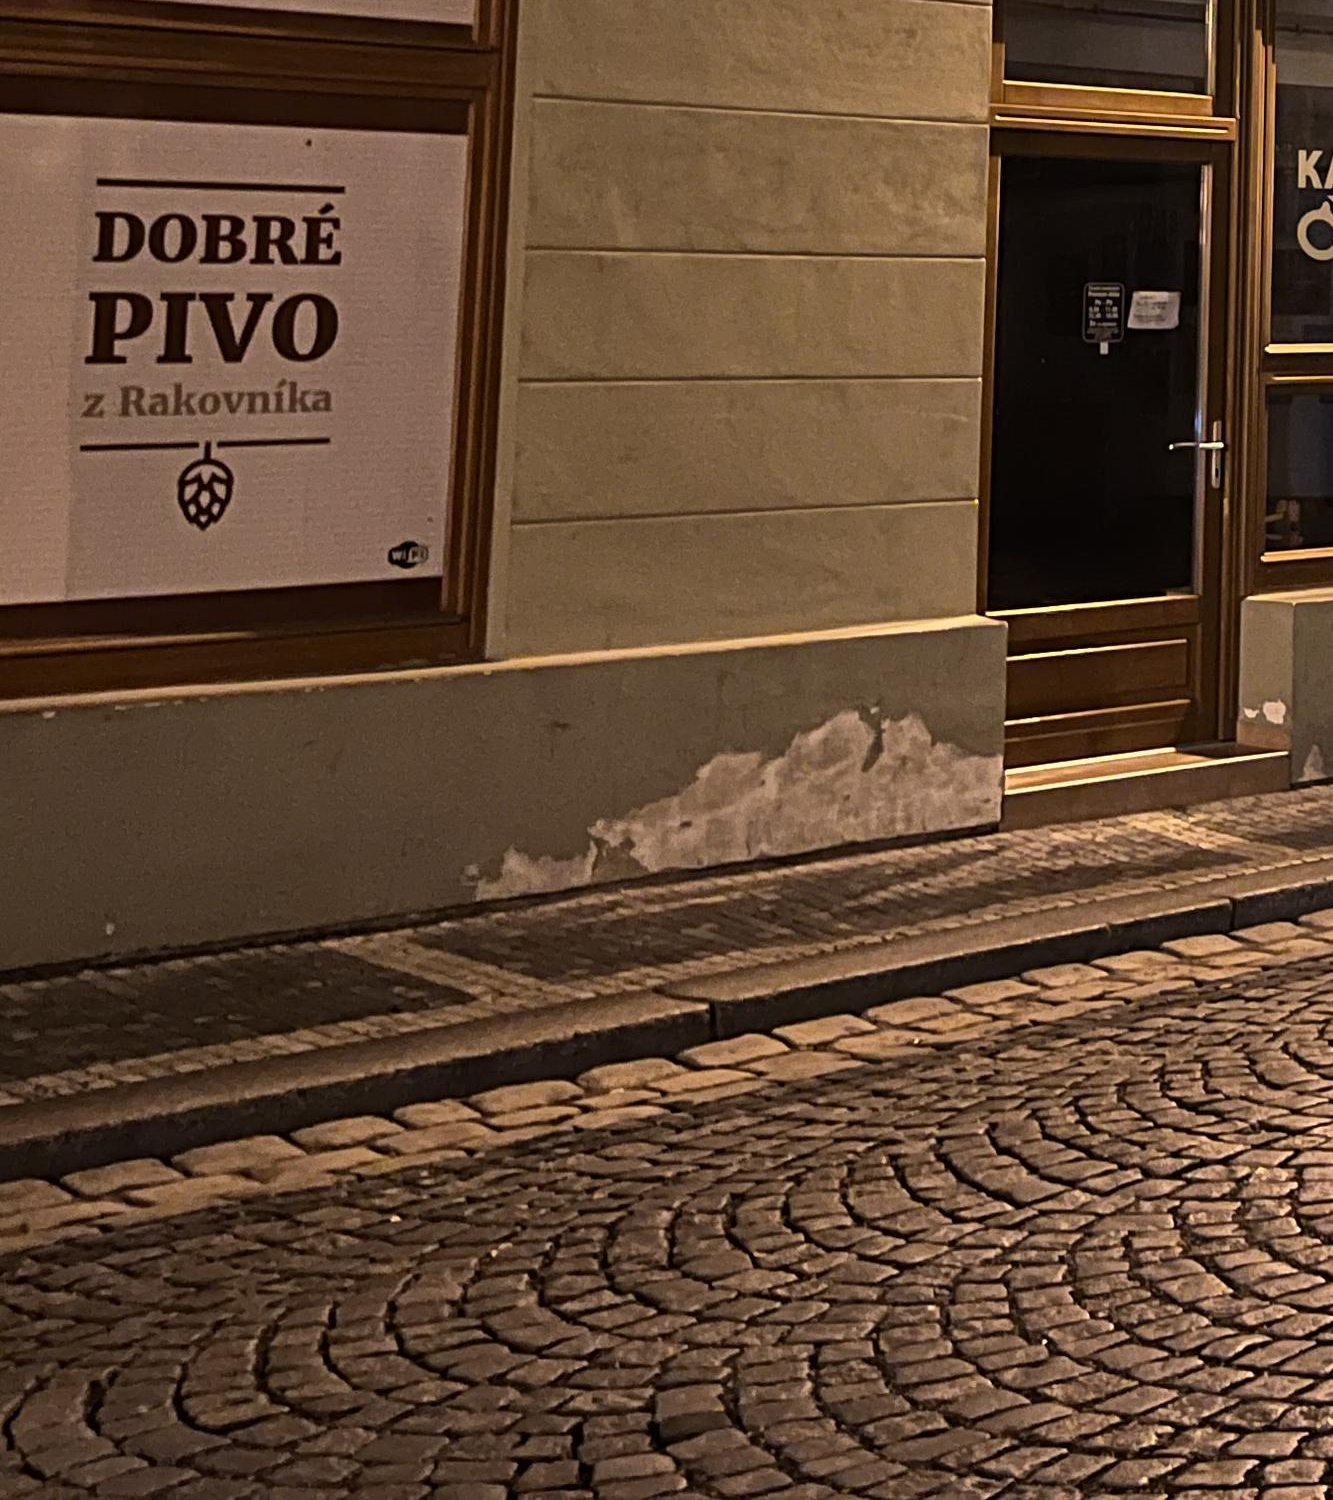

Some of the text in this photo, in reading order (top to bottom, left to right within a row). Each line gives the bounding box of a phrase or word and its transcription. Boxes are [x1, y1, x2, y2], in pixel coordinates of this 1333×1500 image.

[92, 203, 343, 266] DOBRÉ
[84, 291, 339, 365] PIVO
[81, 378, 333, 418] z Rakovníka
